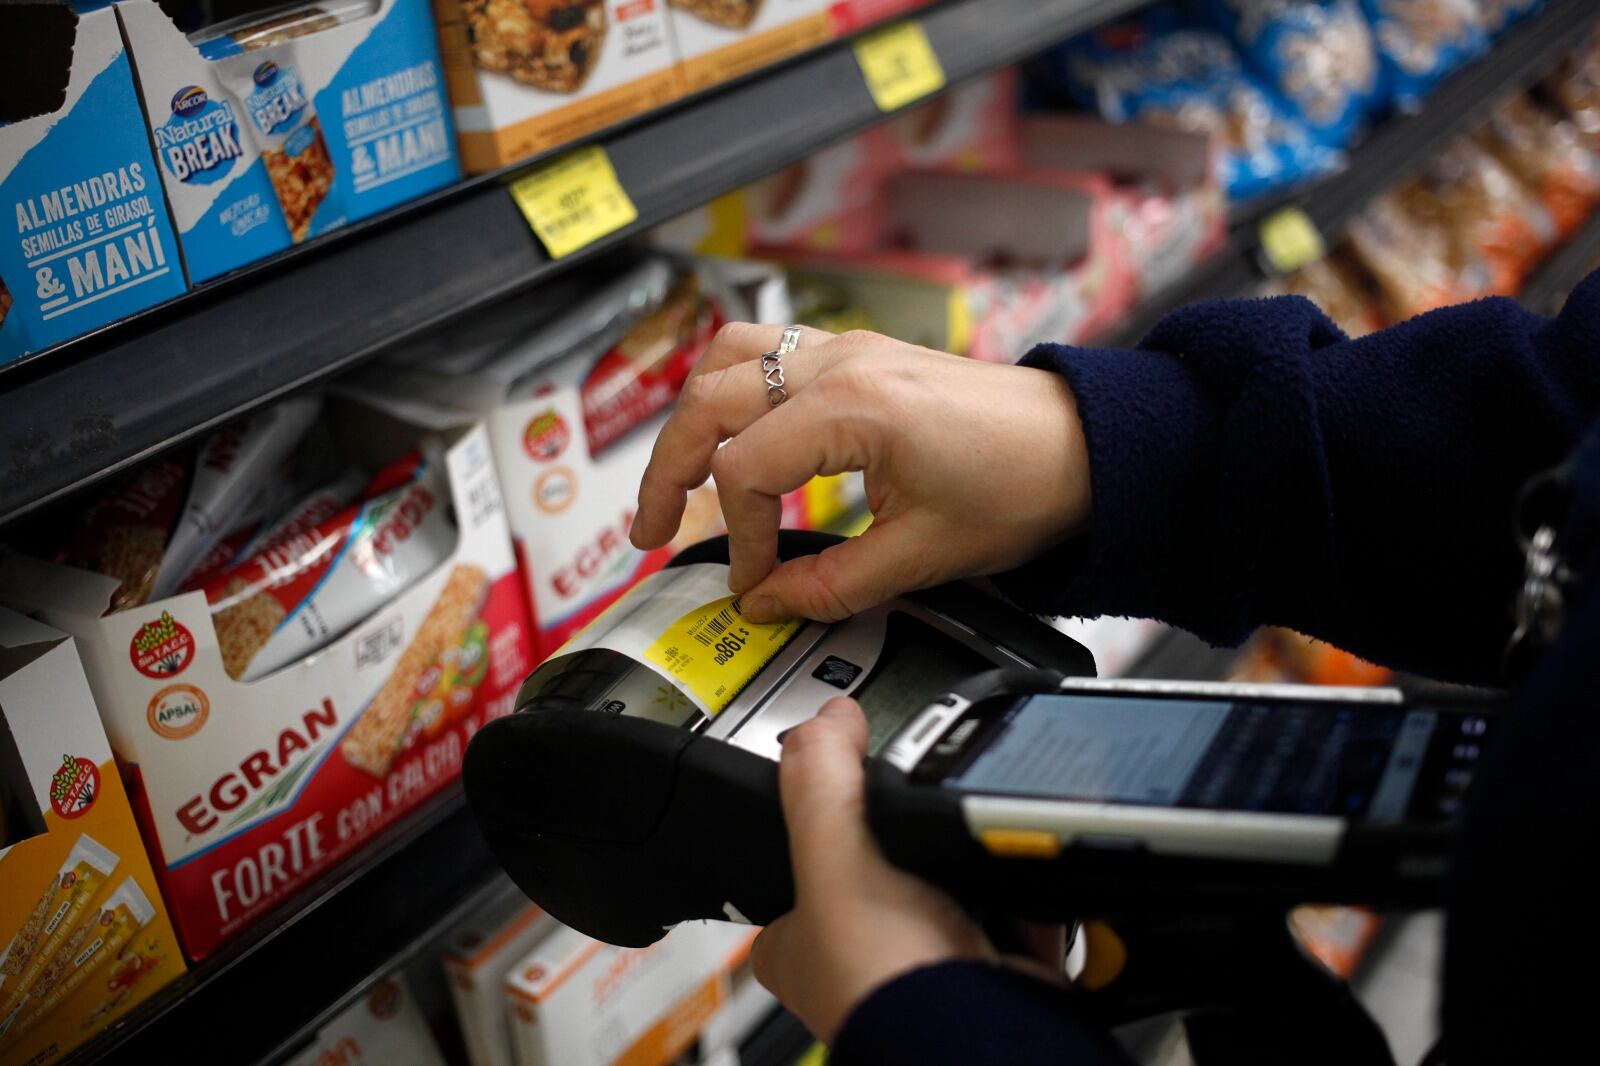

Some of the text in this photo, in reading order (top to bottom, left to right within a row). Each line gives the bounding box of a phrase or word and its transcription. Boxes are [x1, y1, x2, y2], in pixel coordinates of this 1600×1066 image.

[155, 101, 234, 148] Natural
[168, 123, 240, 181] BREAK
[15, 162, 146, 234] ALMENDRAS
[21, 195, 154, 259] SEMILLAS DE GIRASOL
[36, 267, 65, 298] &
[68, 214, 167, 298] MANÍ
[138, 651, 156, 669] Sin
[158, 702, 199, 723] APSAL
[176, 697, 339, 835] EGRAN
[61, 793, 75, 815] Sin
[211, 812, 325, 923] FORTE
[336, 785, 388, 842] CON
